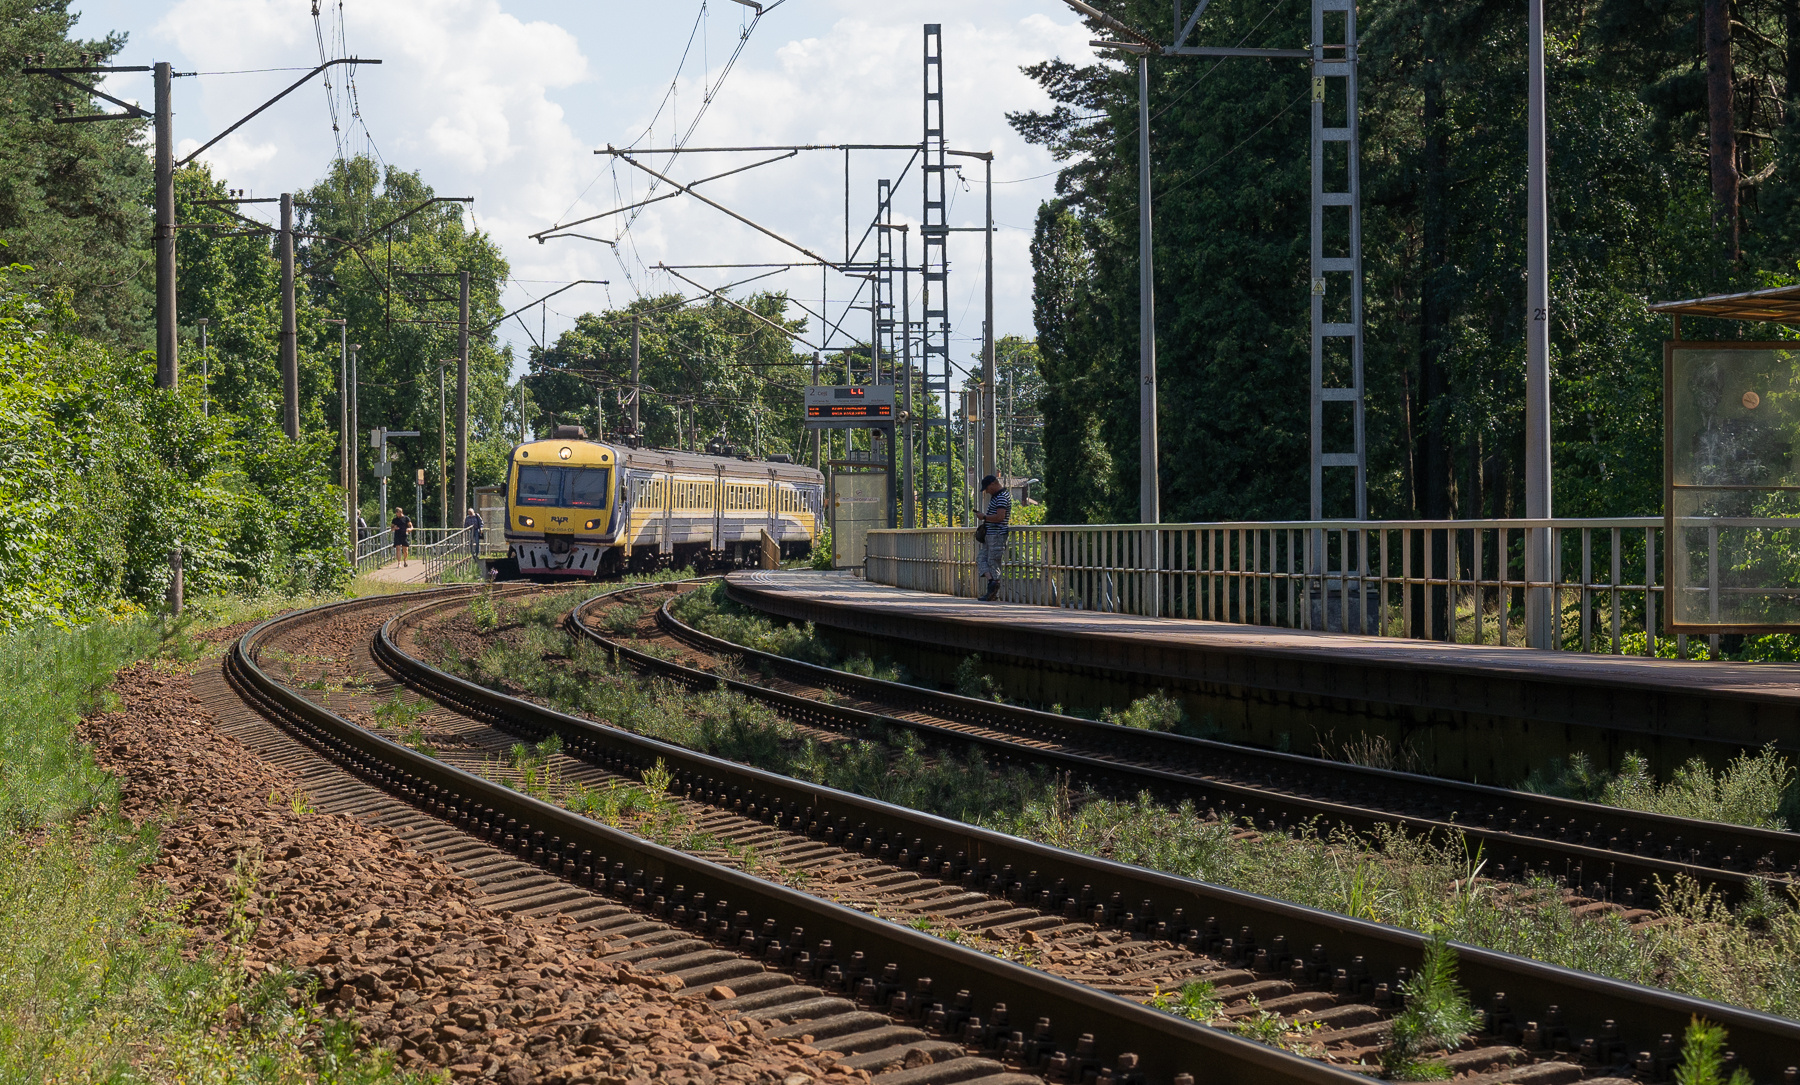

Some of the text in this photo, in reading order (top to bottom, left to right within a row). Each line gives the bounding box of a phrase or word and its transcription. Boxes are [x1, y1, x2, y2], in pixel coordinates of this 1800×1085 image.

[1534, 308, 1546, 321] 25
[1144, 376, 1153, 385] 24
[809, 388, 816, 396] 2
[551, 516, 568, 526] RVR
